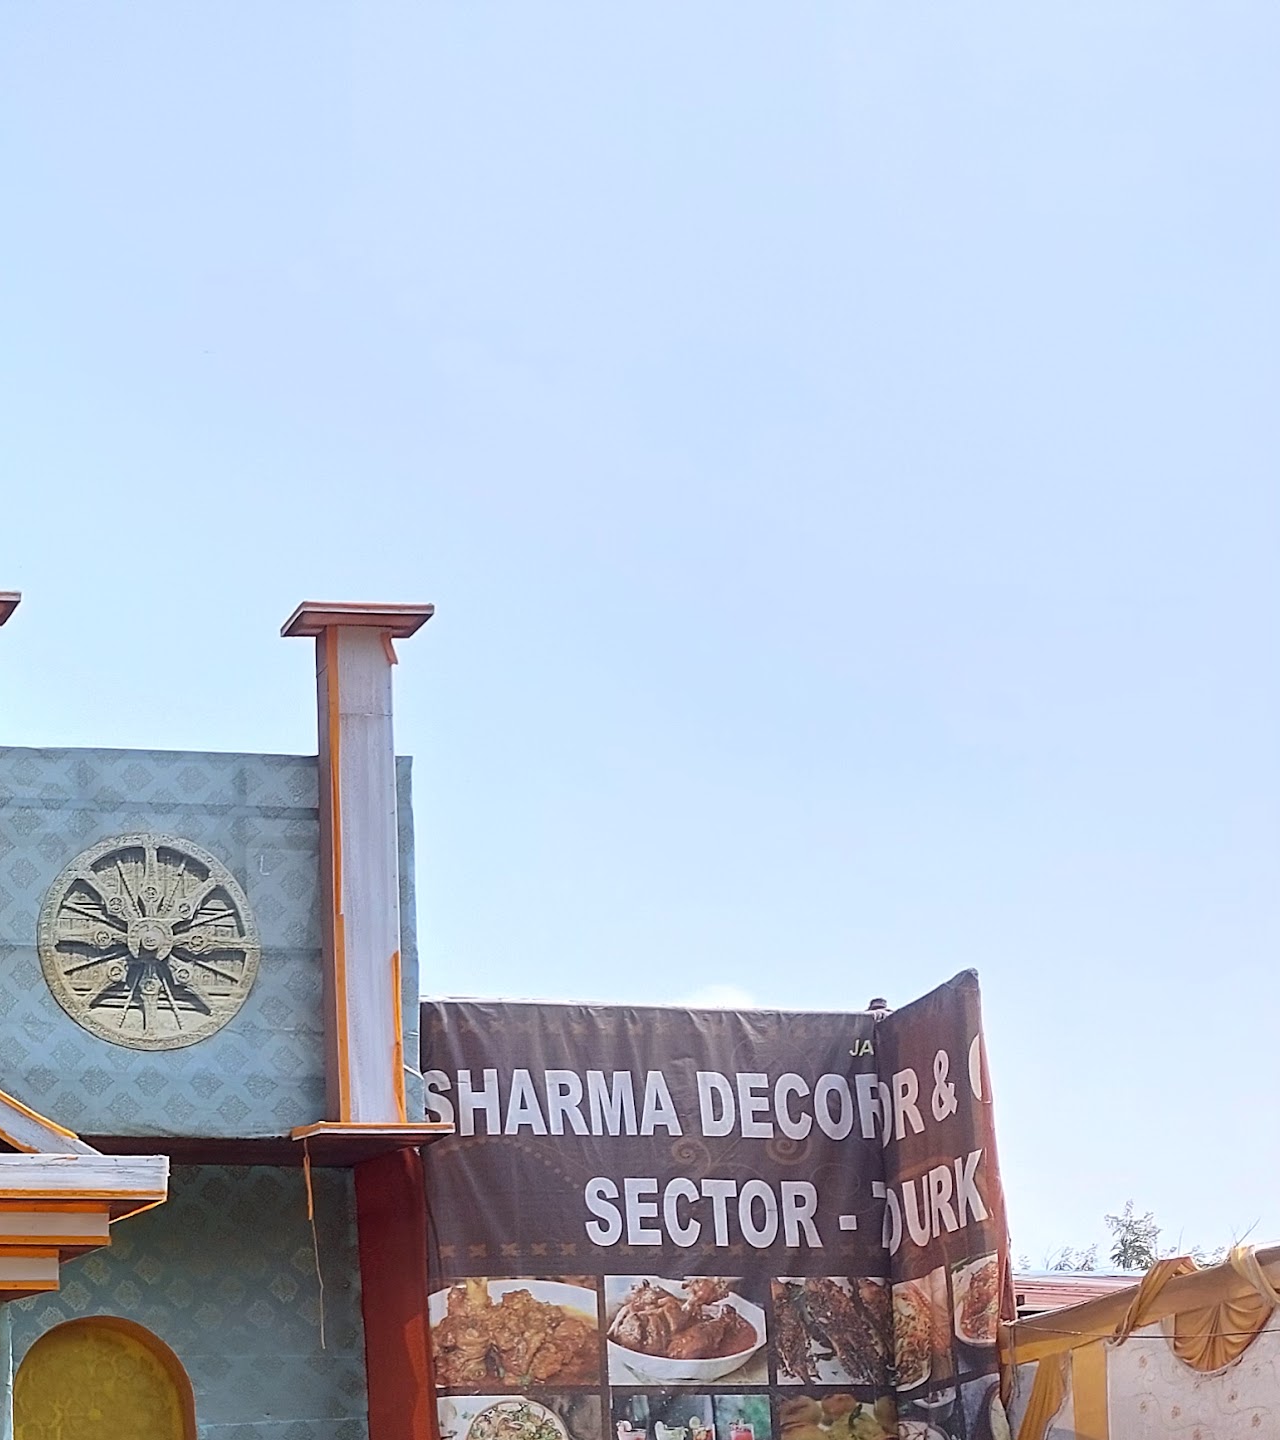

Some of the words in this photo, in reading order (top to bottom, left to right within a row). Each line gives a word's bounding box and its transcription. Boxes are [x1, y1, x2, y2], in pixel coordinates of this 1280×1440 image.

[423, 1068, 683, 1138] SHARMA
[931, 1049, 958, 1122] &
[584, 1176, 824, 1249] SECTOR
